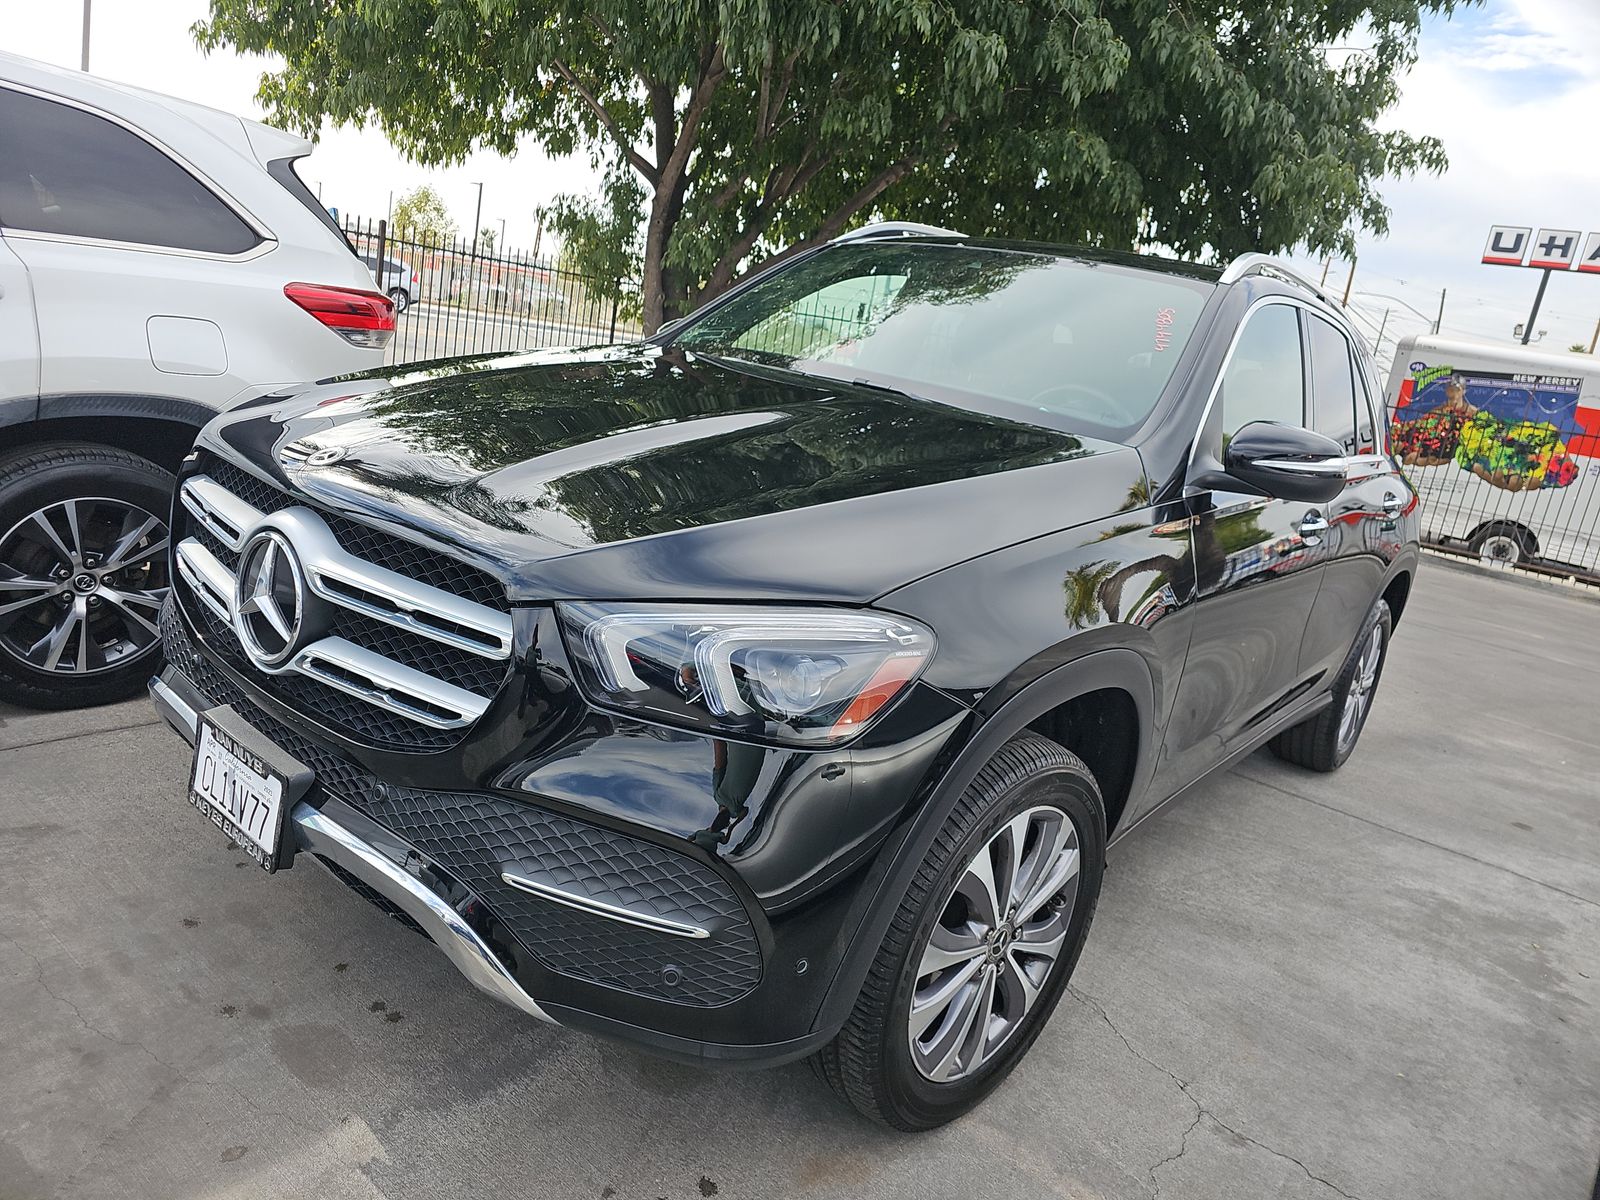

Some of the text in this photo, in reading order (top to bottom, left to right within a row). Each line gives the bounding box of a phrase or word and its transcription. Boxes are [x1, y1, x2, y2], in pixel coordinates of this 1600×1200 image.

[1512, 373, 1537, 384] NEW
[1538, 375, 1580, 386] JERSEY
[233, 741, 264, 775] NUYS
[201, 755, 270, 841] CL11V77
